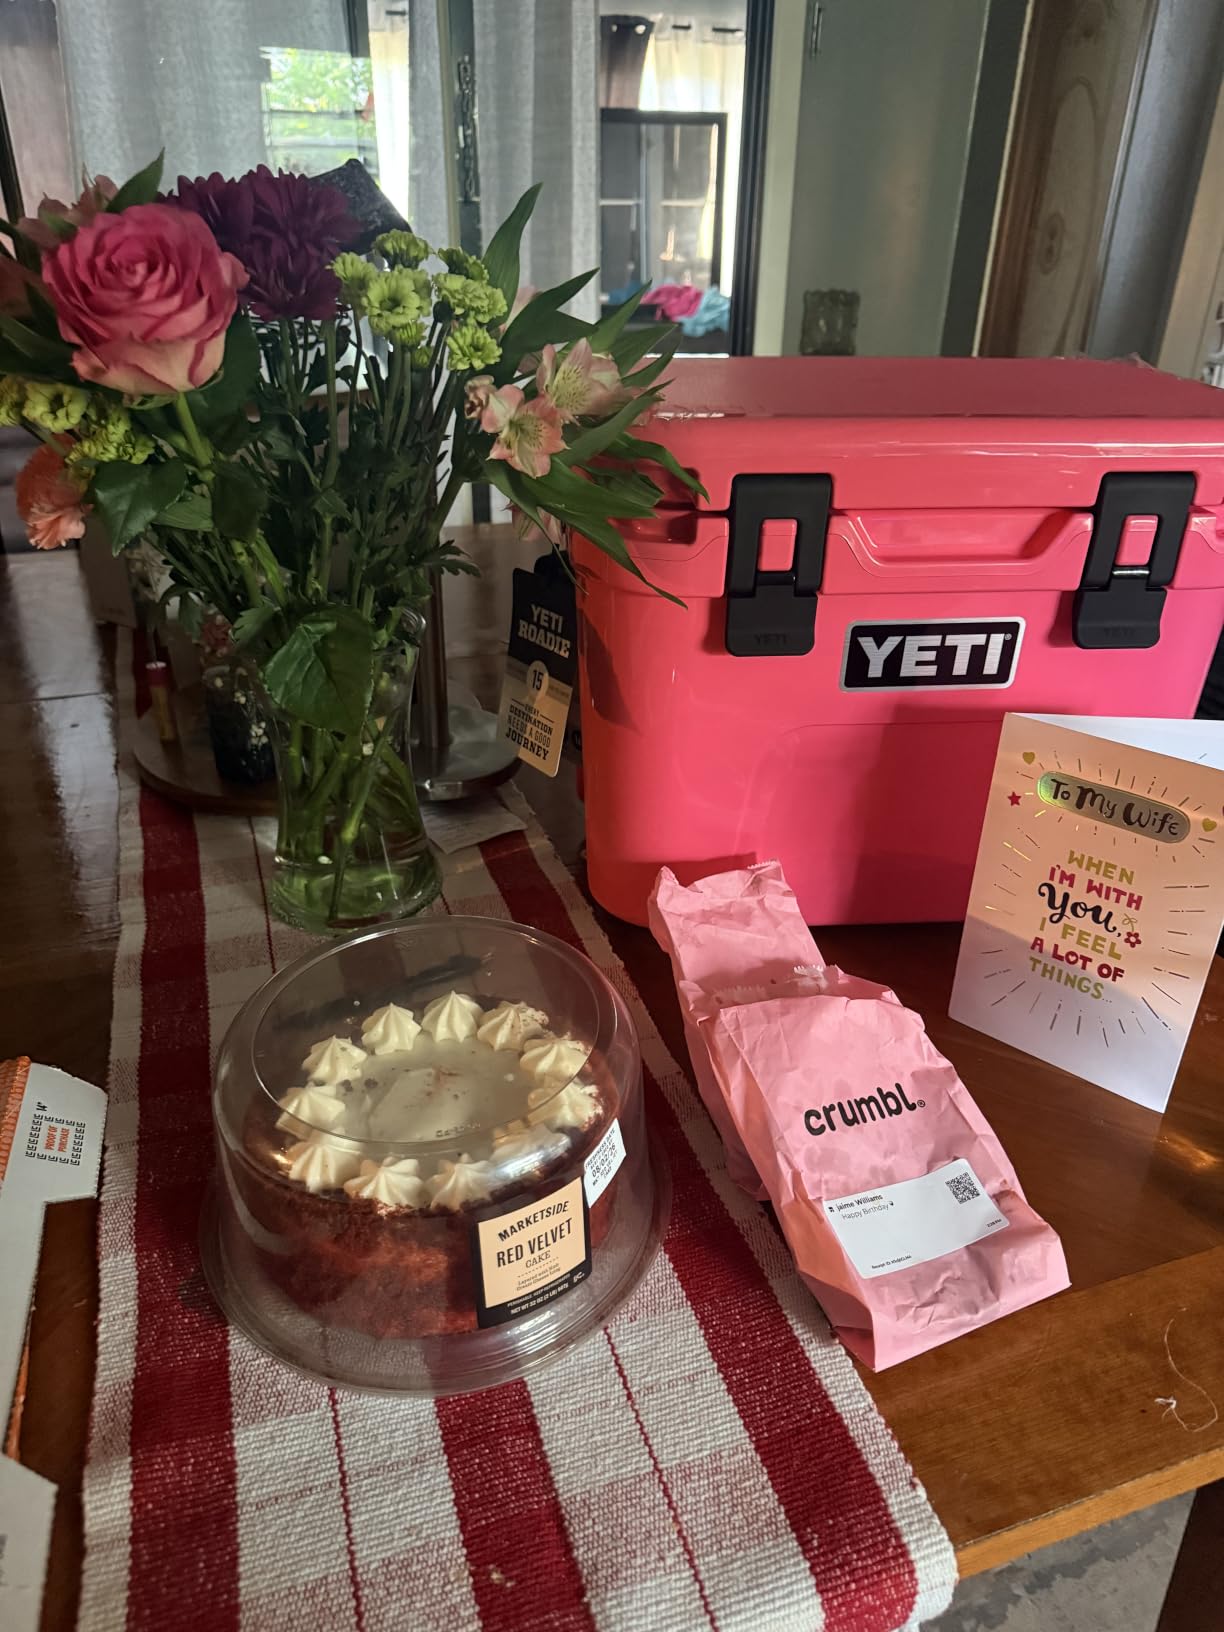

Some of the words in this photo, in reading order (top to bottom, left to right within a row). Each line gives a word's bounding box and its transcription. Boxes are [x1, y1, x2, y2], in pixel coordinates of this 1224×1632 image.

[531, 604, 563, 633] YETI
[518, 620, 571, 659] ROADIE
[532, 670, 543, 691] 15
[508, 715, 527, 736] NEEDS
[529, 726, 534, 737] A
[535, 729, 551, 748] GOOD
[509, 705, 553, 737] DESTINATION
[506, 727, 549, 761] JOURNEY
[1050, 778, 1071, 801] To
[1076, 785, 1117, 819] My
[1067, 850, 1135, 885] WHEN
[1049, 864, 1076, 889] I'M
[1086, 878, 1143, 911] WITH
[1039, 917, 1047, 932] I
[1061, 923, 1122, 961] FEEL
[1030, 936, 1044, 953] A
[1052, 943, 1093, 970] LOT
[1097, 963, 1125, 982] OF
[1029, 956, 1104, 1000] THINGS
[842, 1211, 863, 1220] Happy
[862, 1203, 889, 1215] Birthday
[855, 1194, 883, 1206] Williams
[498, 1200, 569, 1242] MARKETSIDE
[496, 1243, 523, 1268] RED
[528, 1217, 573, 1255] VELVET
[525, 1250, 551, 1269] CAKE
